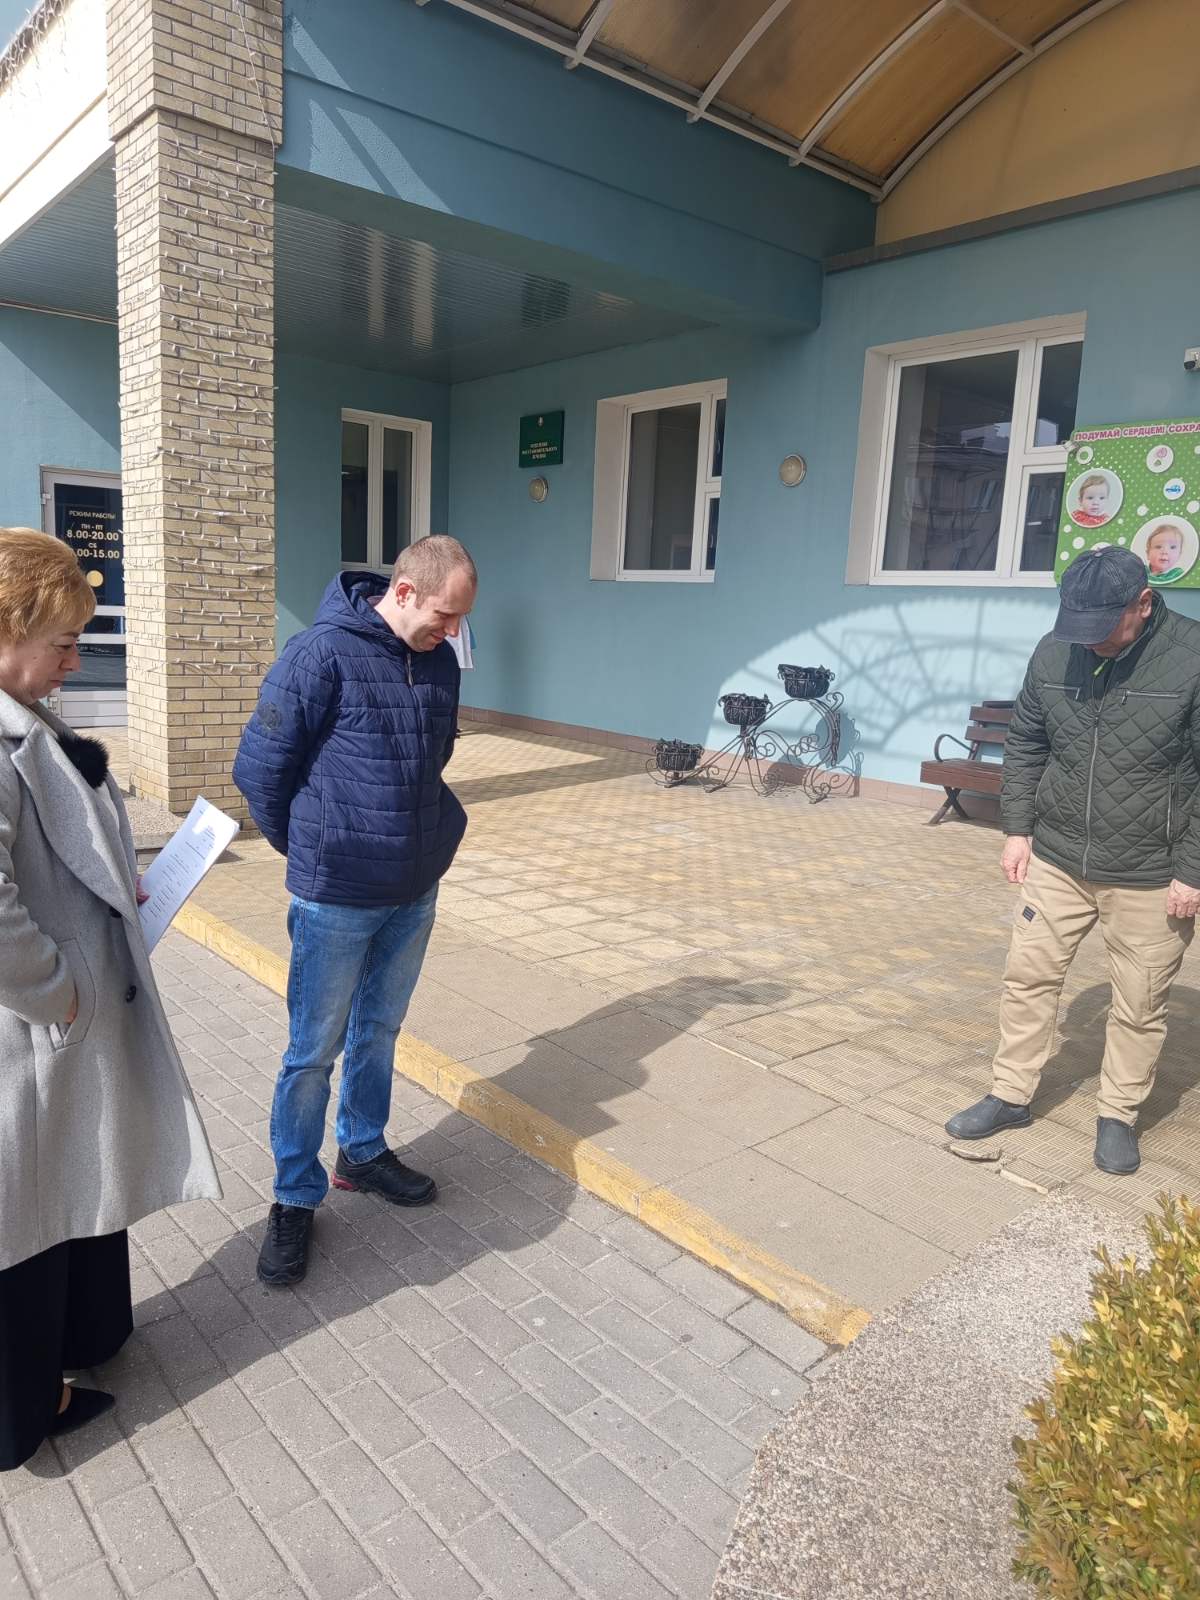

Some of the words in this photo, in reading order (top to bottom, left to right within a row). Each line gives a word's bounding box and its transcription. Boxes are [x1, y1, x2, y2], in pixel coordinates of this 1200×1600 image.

[1075, 429, 1120, 440] ПОДУМАЙ
[1123, 426, 1165, 436] СЕРДЦЕМ!
[67, 529, 119, 541] 8.00-20.00
[77, 548, 119, 558] 00-15.00
